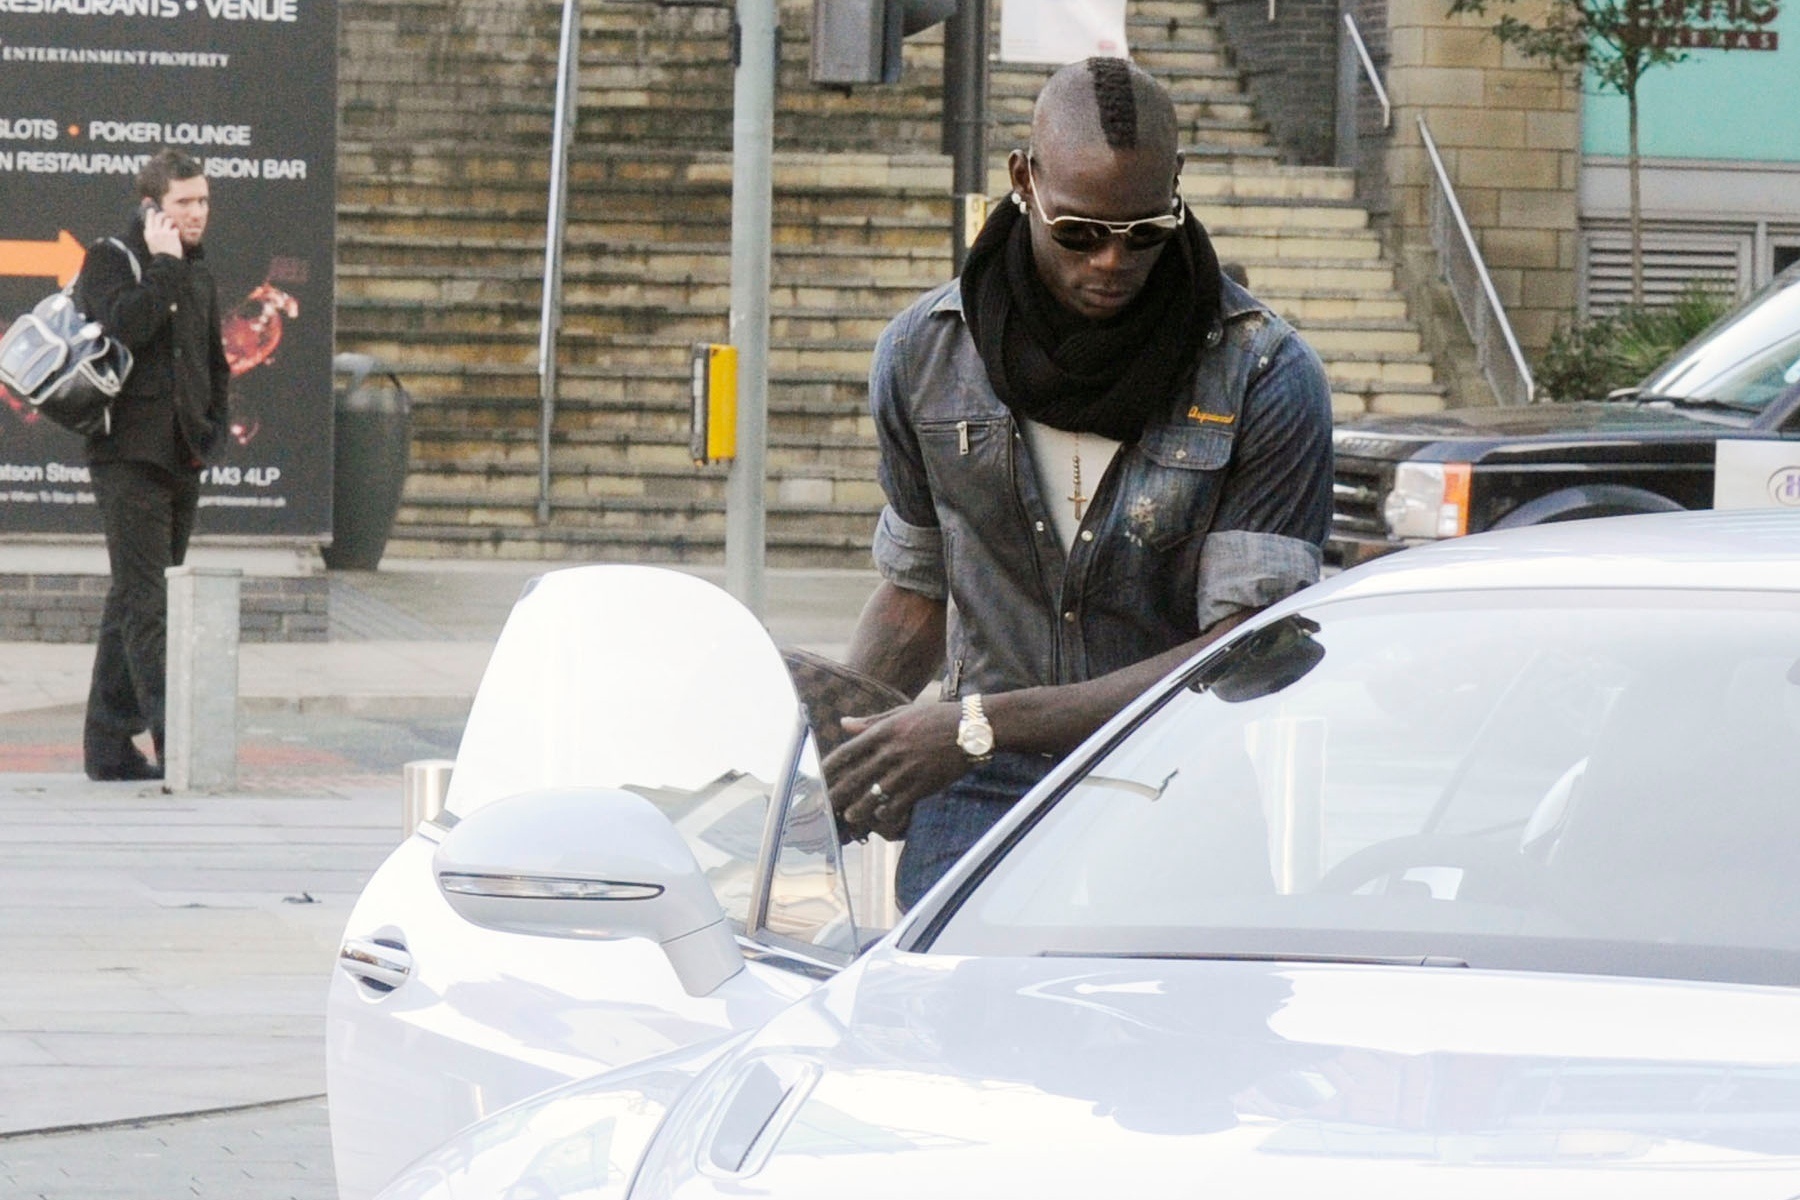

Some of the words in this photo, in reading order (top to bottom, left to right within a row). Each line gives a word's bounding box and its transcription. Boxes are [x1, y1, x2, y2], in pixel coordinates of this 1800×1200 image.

[206, 0, 298, 22] VENUE
[3, 46, 148, 64] ENTERTAINMENT
[150, 51, 230, 67] PROPERTY
[89, 121, 161, 143] POKER
[164, 123, 251, 146] LOUNGE
[263, 158, 307, 179] BAR
